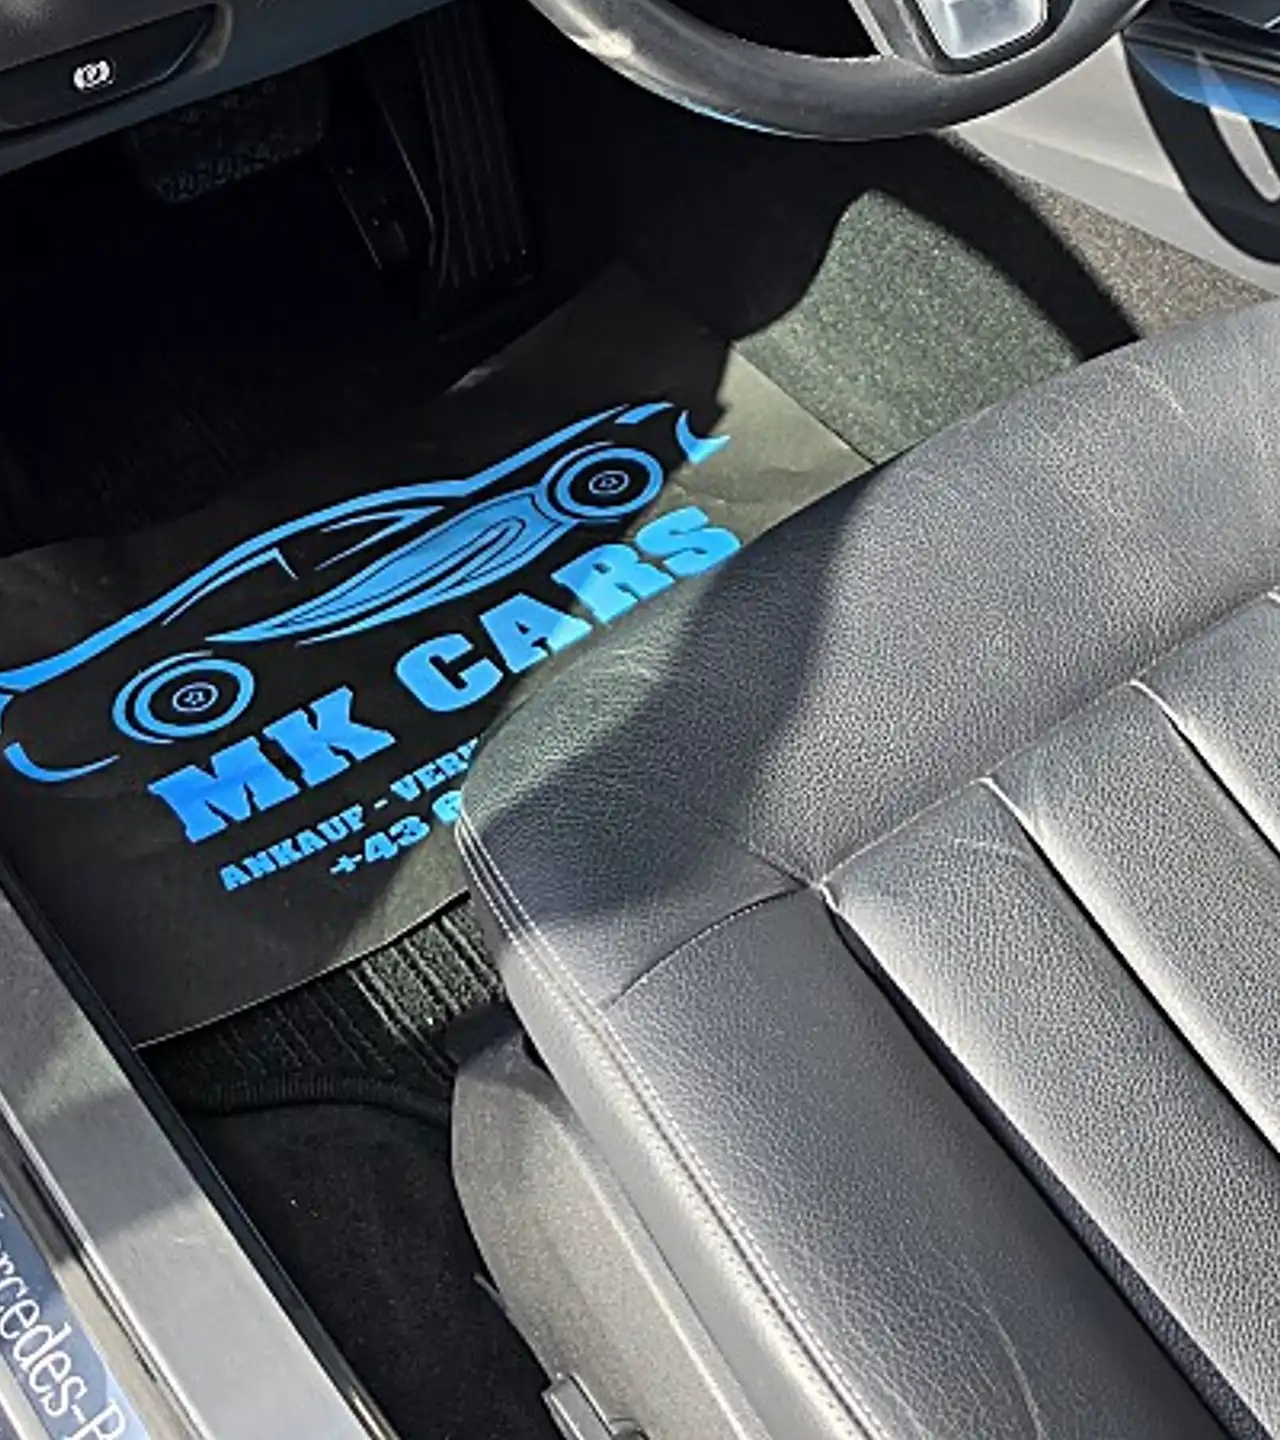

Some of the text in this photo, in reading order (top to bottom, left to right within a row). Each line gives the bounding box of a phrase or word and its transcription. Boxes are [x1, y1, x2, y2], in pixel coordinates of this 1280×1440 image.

[146, 504, 741, 845] MK CARS
[219, 803, 366, 892] ANKAUF
[329, 815, 431, 875] +43
